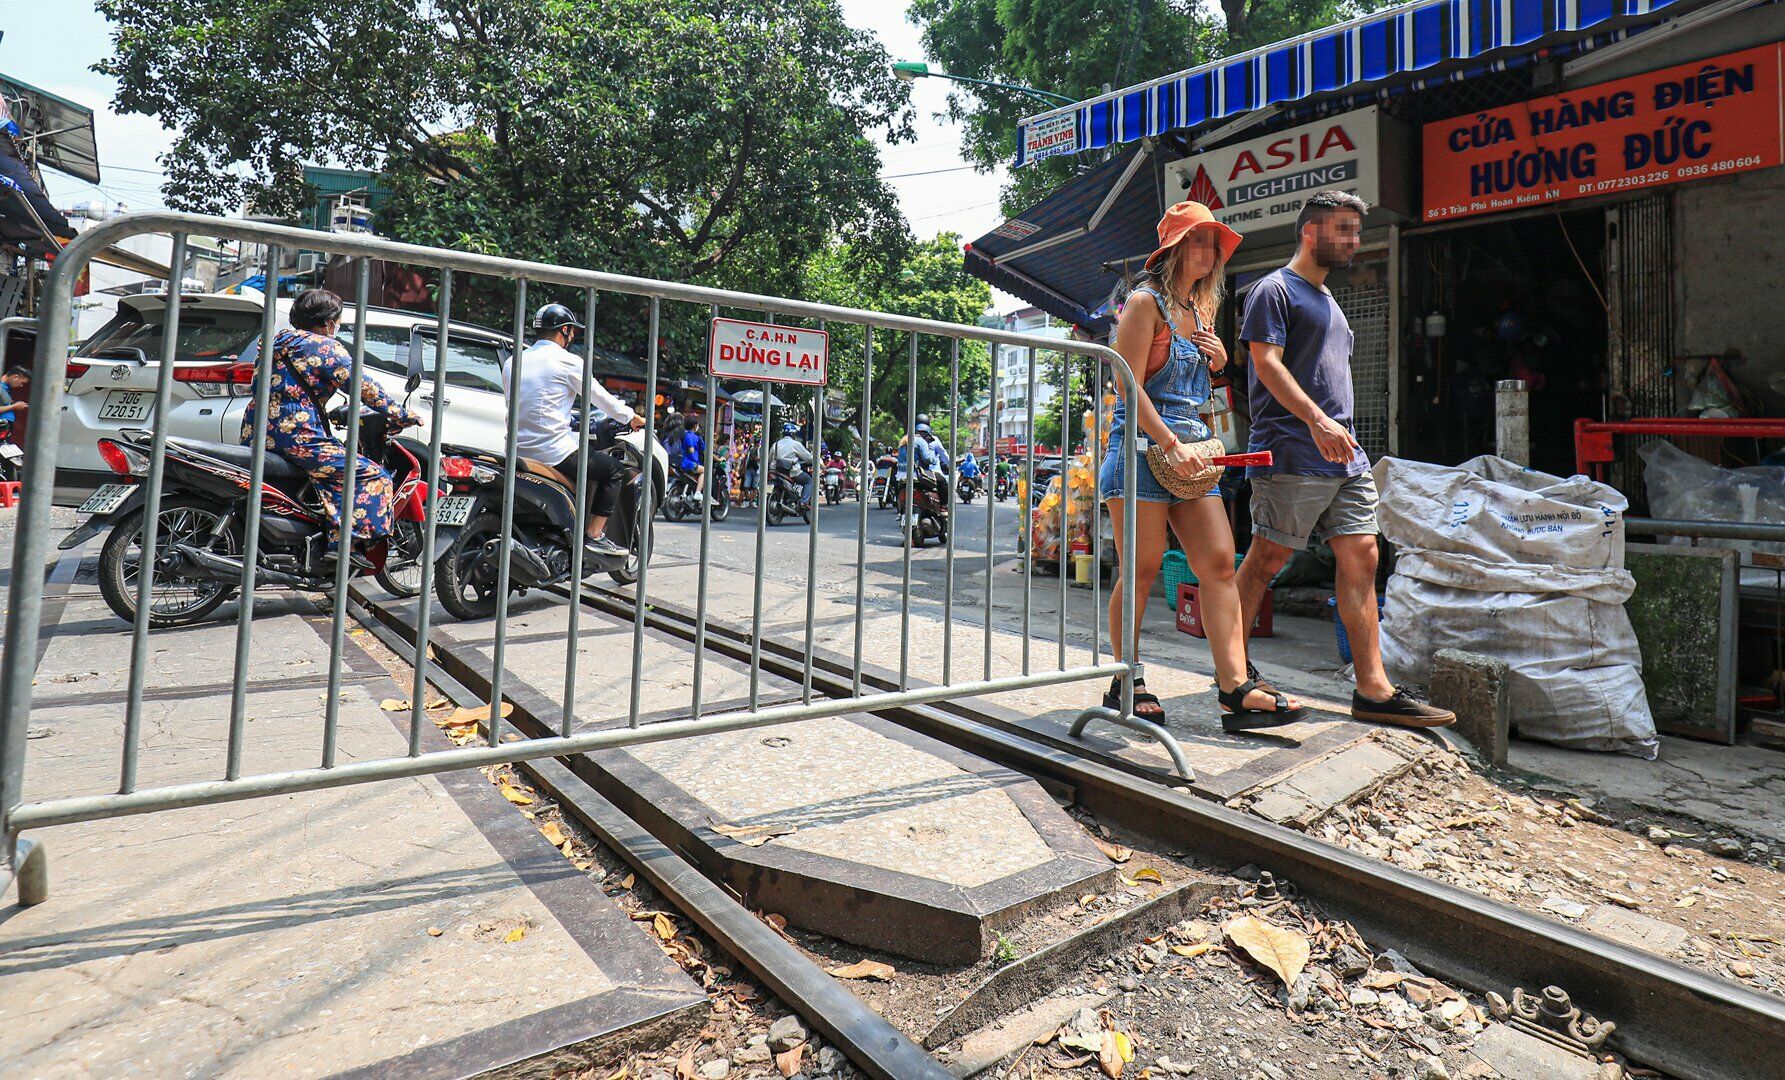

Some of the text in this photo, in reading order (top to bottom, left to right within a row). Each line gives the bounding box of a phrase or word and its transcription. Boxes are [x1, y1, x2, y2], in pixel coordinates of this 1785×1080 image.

[1449, 64, 1754, 153] CỬA HÀNG ĐIỆN
[1228, 124, 1357, 182] ASIA
[1470, 115, 1712, 198] HƯƠNG ĐỨC
[1235, 165, 1346, 203] LIGHTING
[1222, 207, 1263, 225] HOME
[1441, 207, 1447, 216] 3
[1449, 204, 1468, 214] Trần
[746, 328, 797, 344] C.A.H.N
[720, 340, 819, 373] DỪNG LẠI
[118, 392, 142, 404] 30G
[105, 405, 143, 419] 720.51
[440, 497, 470, 510] 29-E2
[1535, 511, 1555, 521] HÀNH
